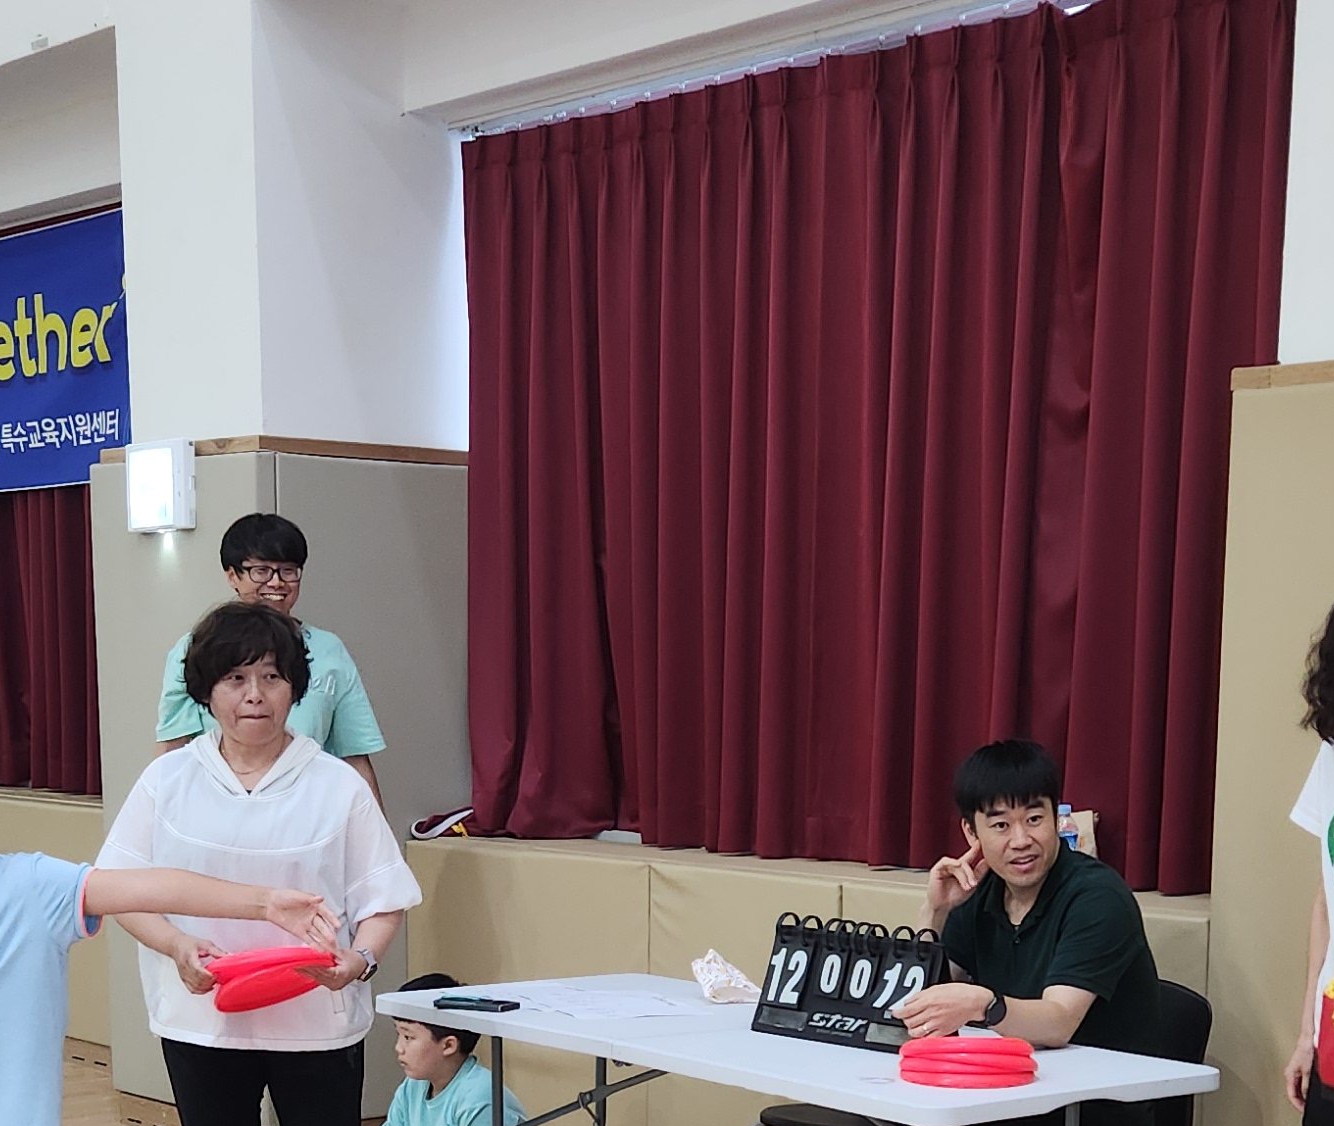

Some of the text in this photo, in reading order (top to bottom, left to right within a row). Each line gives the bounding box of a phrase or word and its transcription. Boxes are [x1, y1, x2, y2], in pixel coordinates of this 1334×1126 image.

[0, 408, 120, 455] 특수교육지원센터
[767, 947, 808, 1004] 12
[872, 962, 925, 1019] 12
